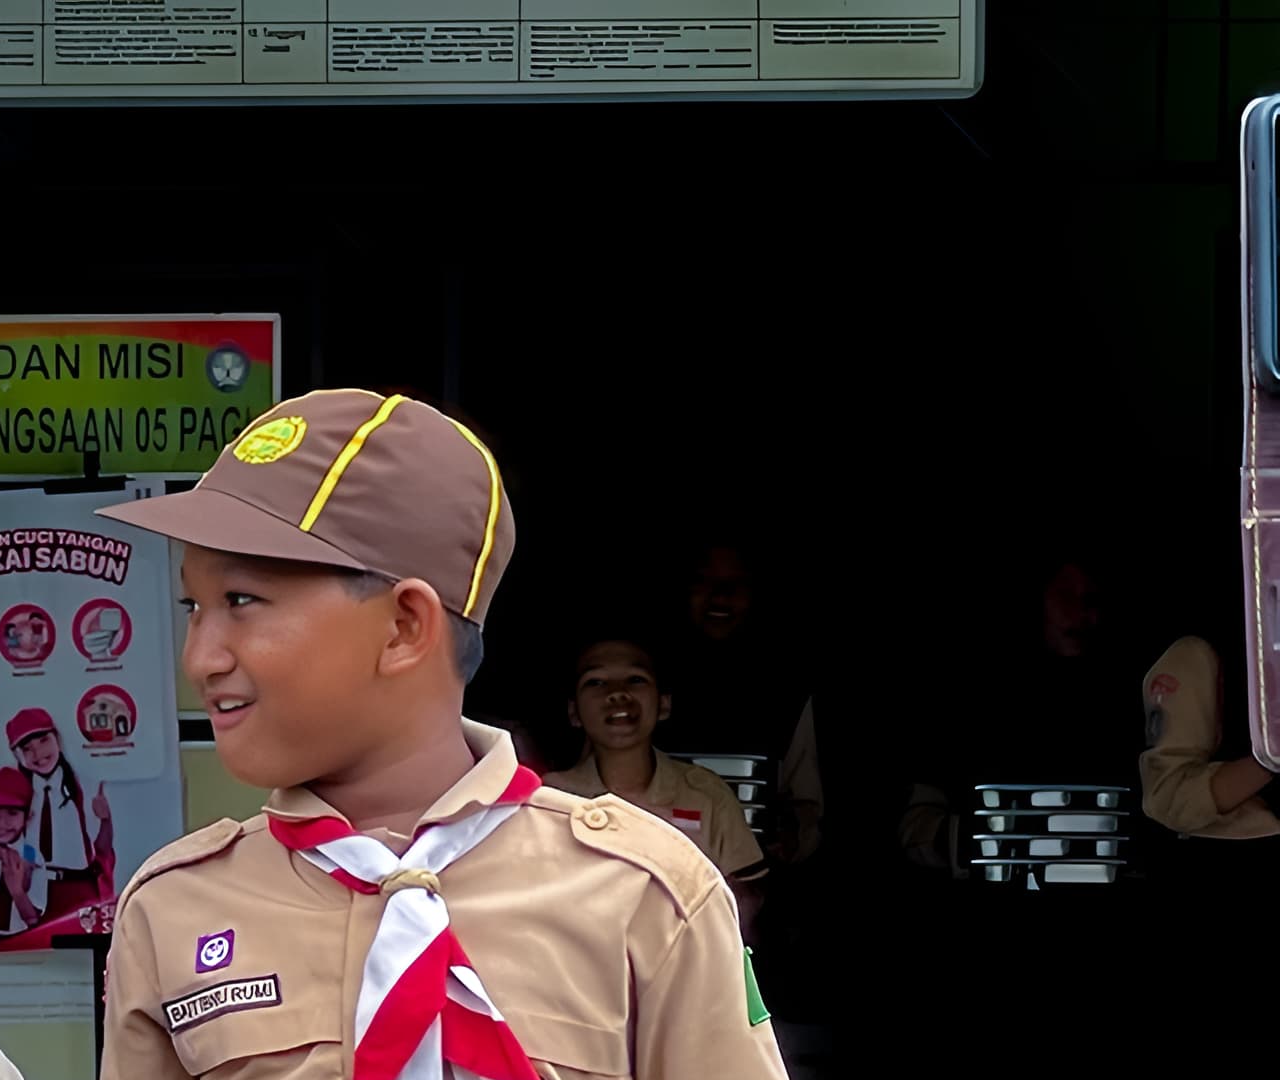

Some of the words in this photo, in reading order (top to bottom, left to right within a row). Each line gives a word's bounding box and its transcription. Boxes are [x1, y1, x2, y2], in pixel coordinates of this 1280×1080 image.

[98, 342, 183, 379] MISI
[135, 406, 168, 453] 05
[179, 406, 252, 452] PAG
[13, 531, 53, 545] CUCI
[56, 530, 130, 559] TANGAN
[35, 547, 127, 583] SABUN
